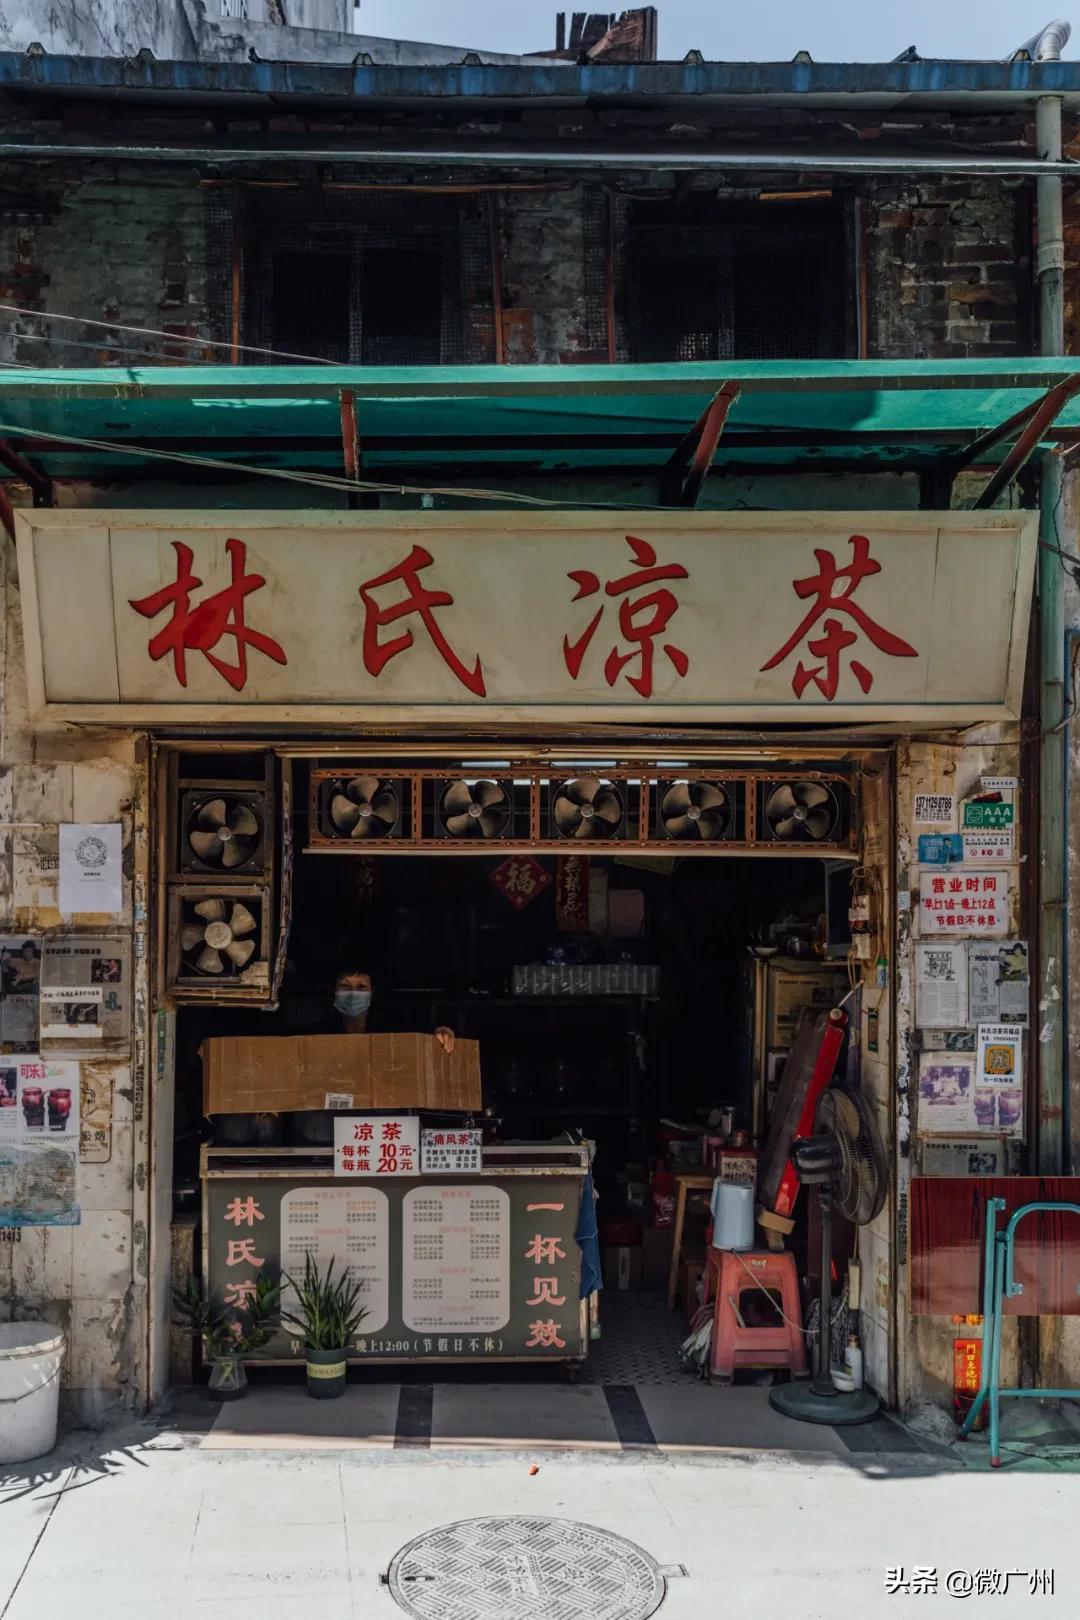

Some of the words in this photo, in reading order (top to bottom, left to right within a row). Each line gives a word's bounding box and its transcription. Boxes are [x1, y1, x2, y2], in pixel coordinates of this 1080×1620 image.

[129, 535, 918, 701] 林氏凉茶
[984, 807, 1011, 816] AAA
[505, 862, 536, 894] 福
[932, 877, 996, 893] 营业时间
[936, 915, 996, 926] 节假日不休息
[354, 1122, 402, 1141] 凉茶
[434, 1133, 470, 1145] 痛风茶
[223, 1196, 265, 1348] 林氏凉
[524, 1203, 567, 1348] 一杯见效
